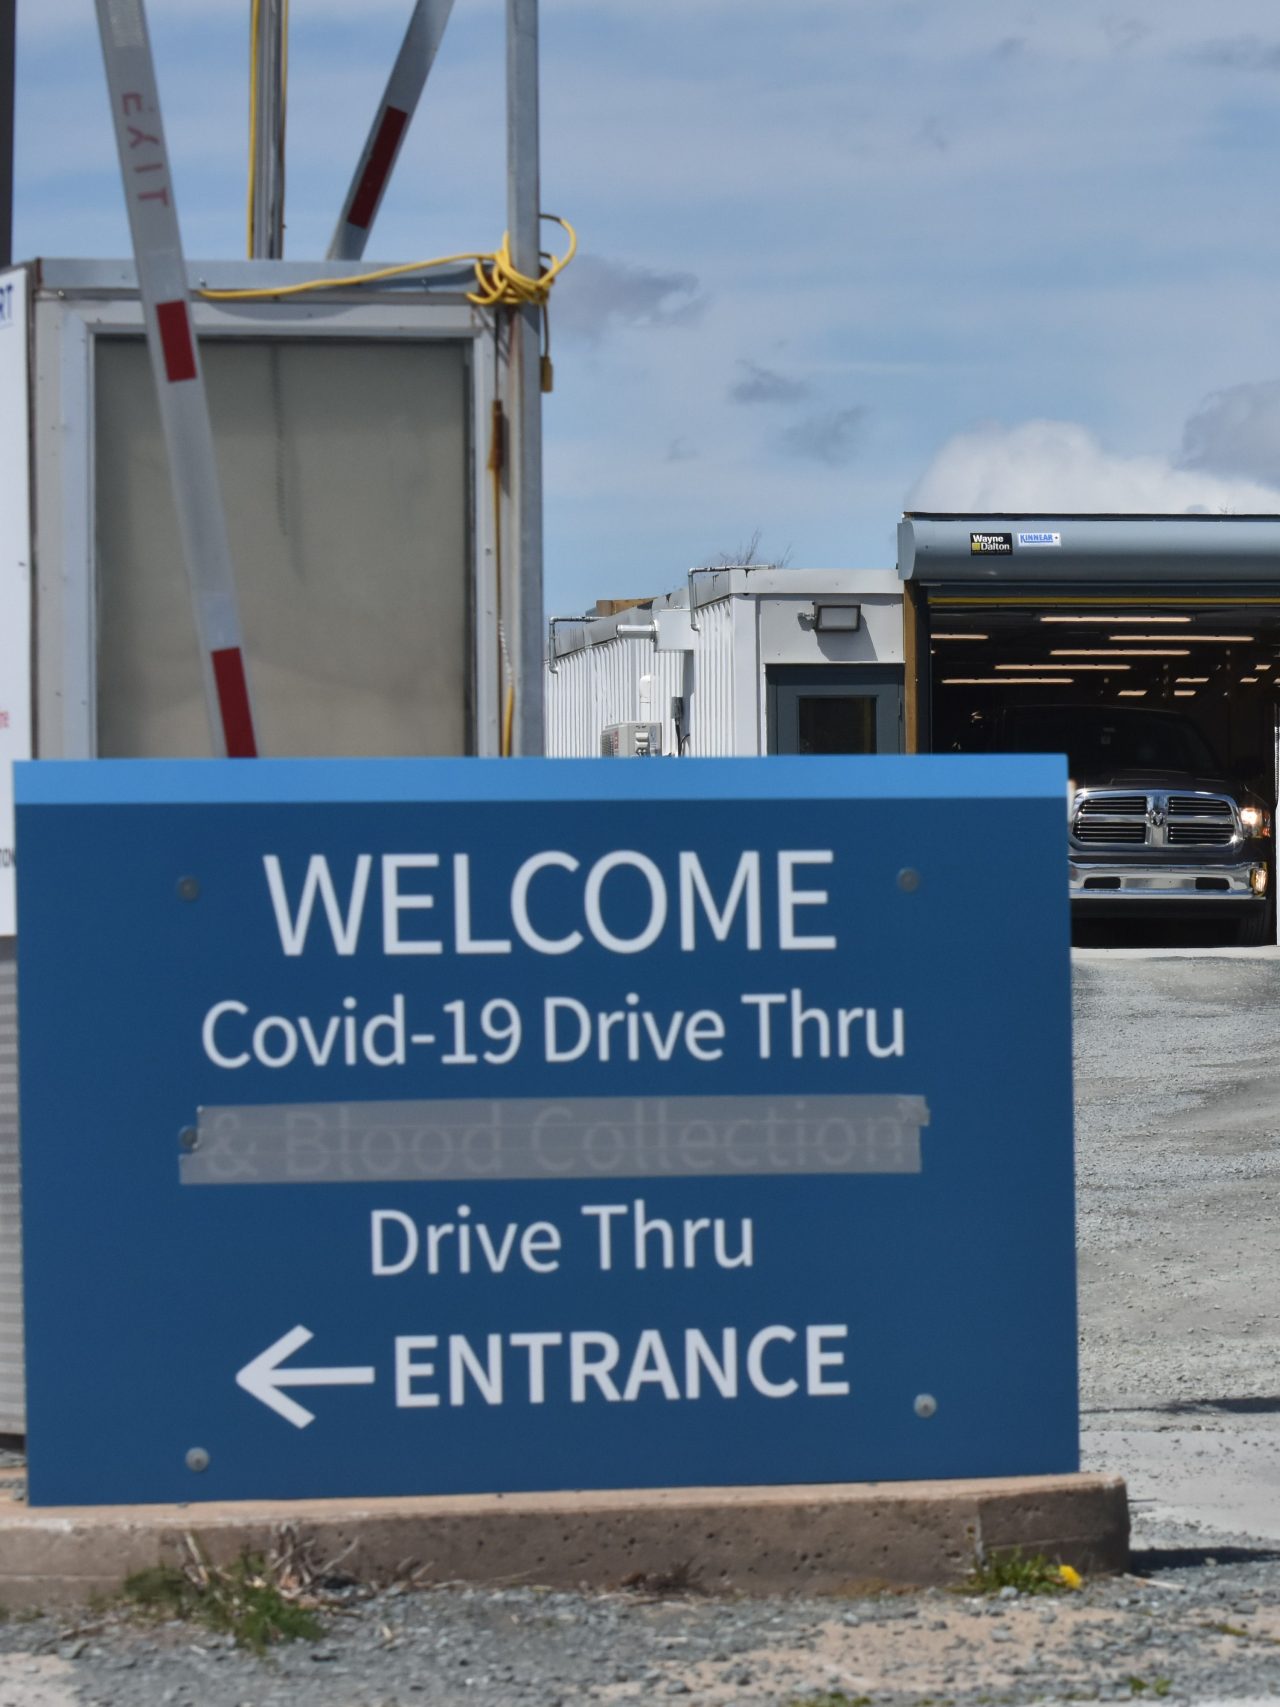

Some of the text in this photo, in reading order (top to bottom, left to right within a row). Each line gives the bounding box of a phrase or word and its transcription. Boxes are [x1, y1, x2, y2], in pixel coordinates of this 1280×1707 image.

[121, 91, 170, 208] EXIT
[973, 534, 1004, 544] Wayne
[981, 543, 1010, 551] Dalton
[1020, 534, 1053, 543] KINNEAR
[263, 850, 837, 956] WELCOME
[202, 988, 904, 1068] Covid-19 Drive Thru
[371, 1199, 753, 1275] Drive Thru
[395, 1324, 850, 1408] ENTRANCE
